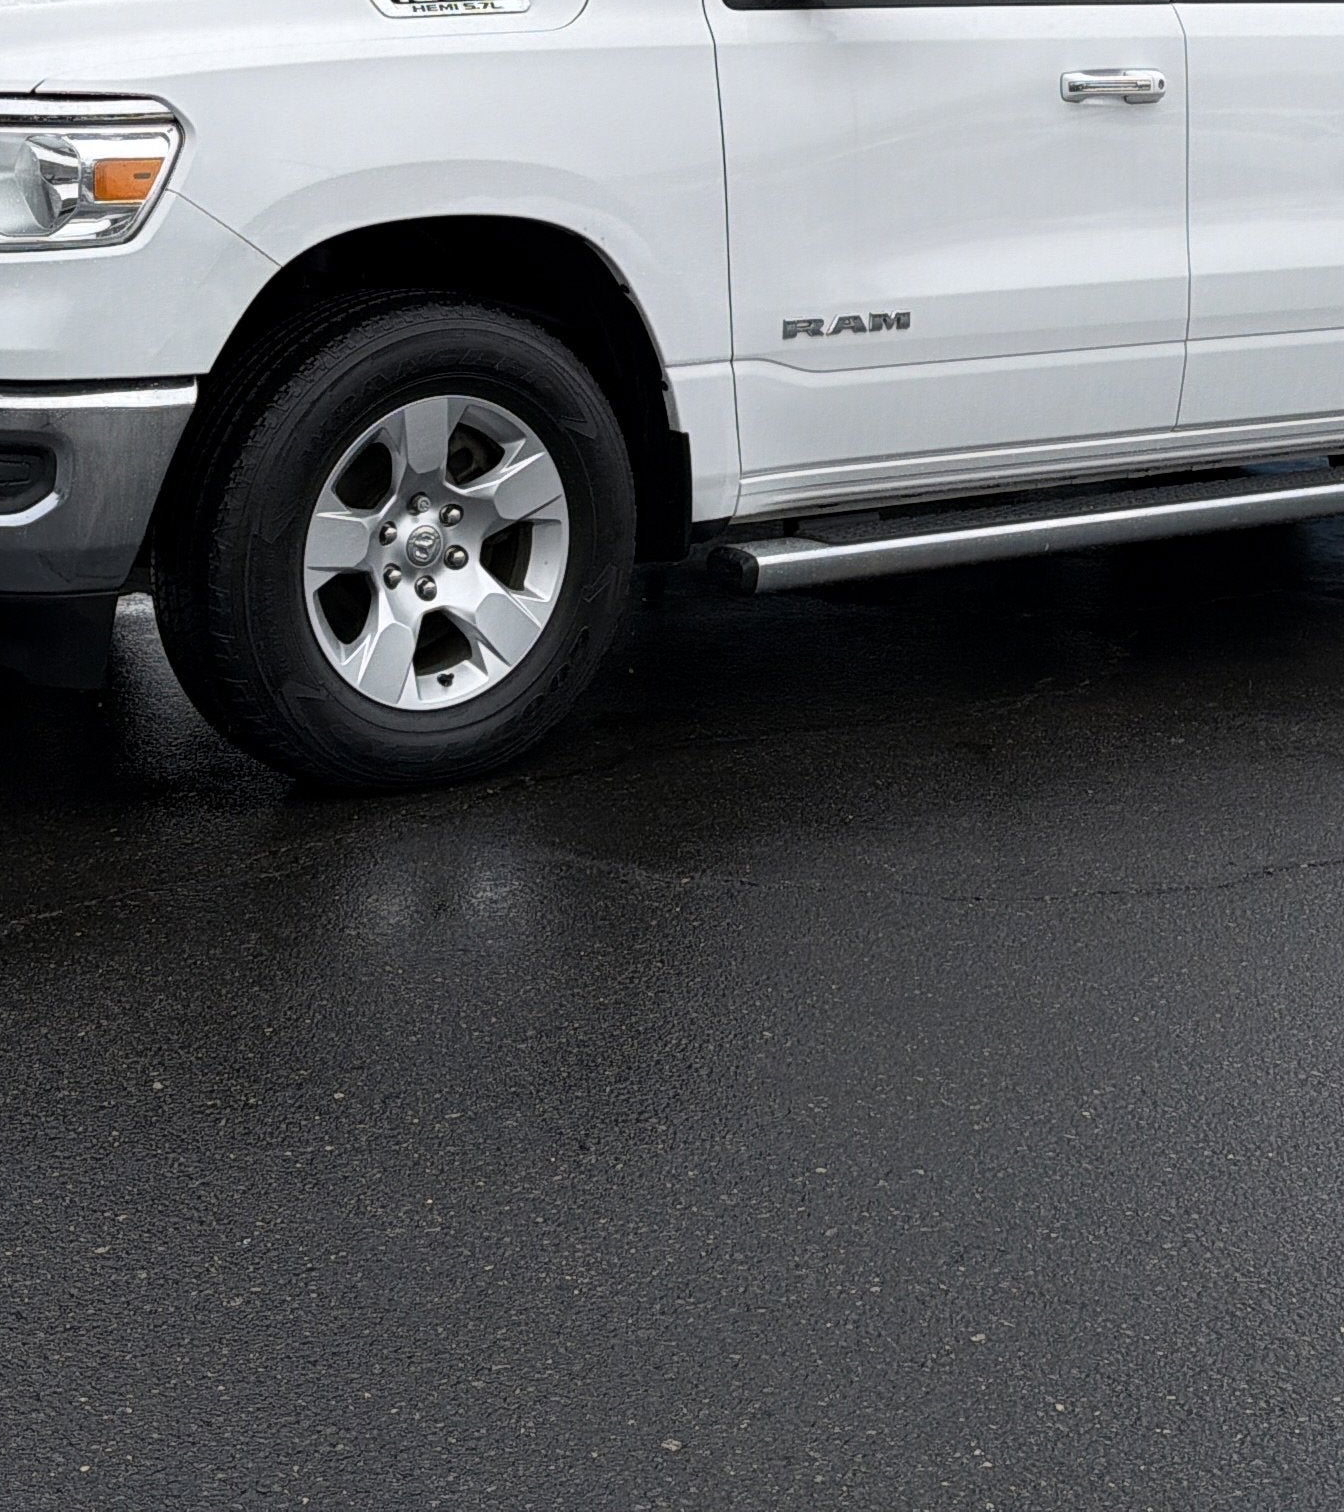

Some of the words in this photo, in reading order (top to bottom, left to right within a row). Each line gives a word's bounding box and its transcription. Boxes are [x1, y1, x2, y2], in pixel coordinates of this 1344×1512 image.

[412, 3, 459, 13] HEMI
[463, 1, 504, 11] 5.7L
[782, 310, 911, 340] RAM
